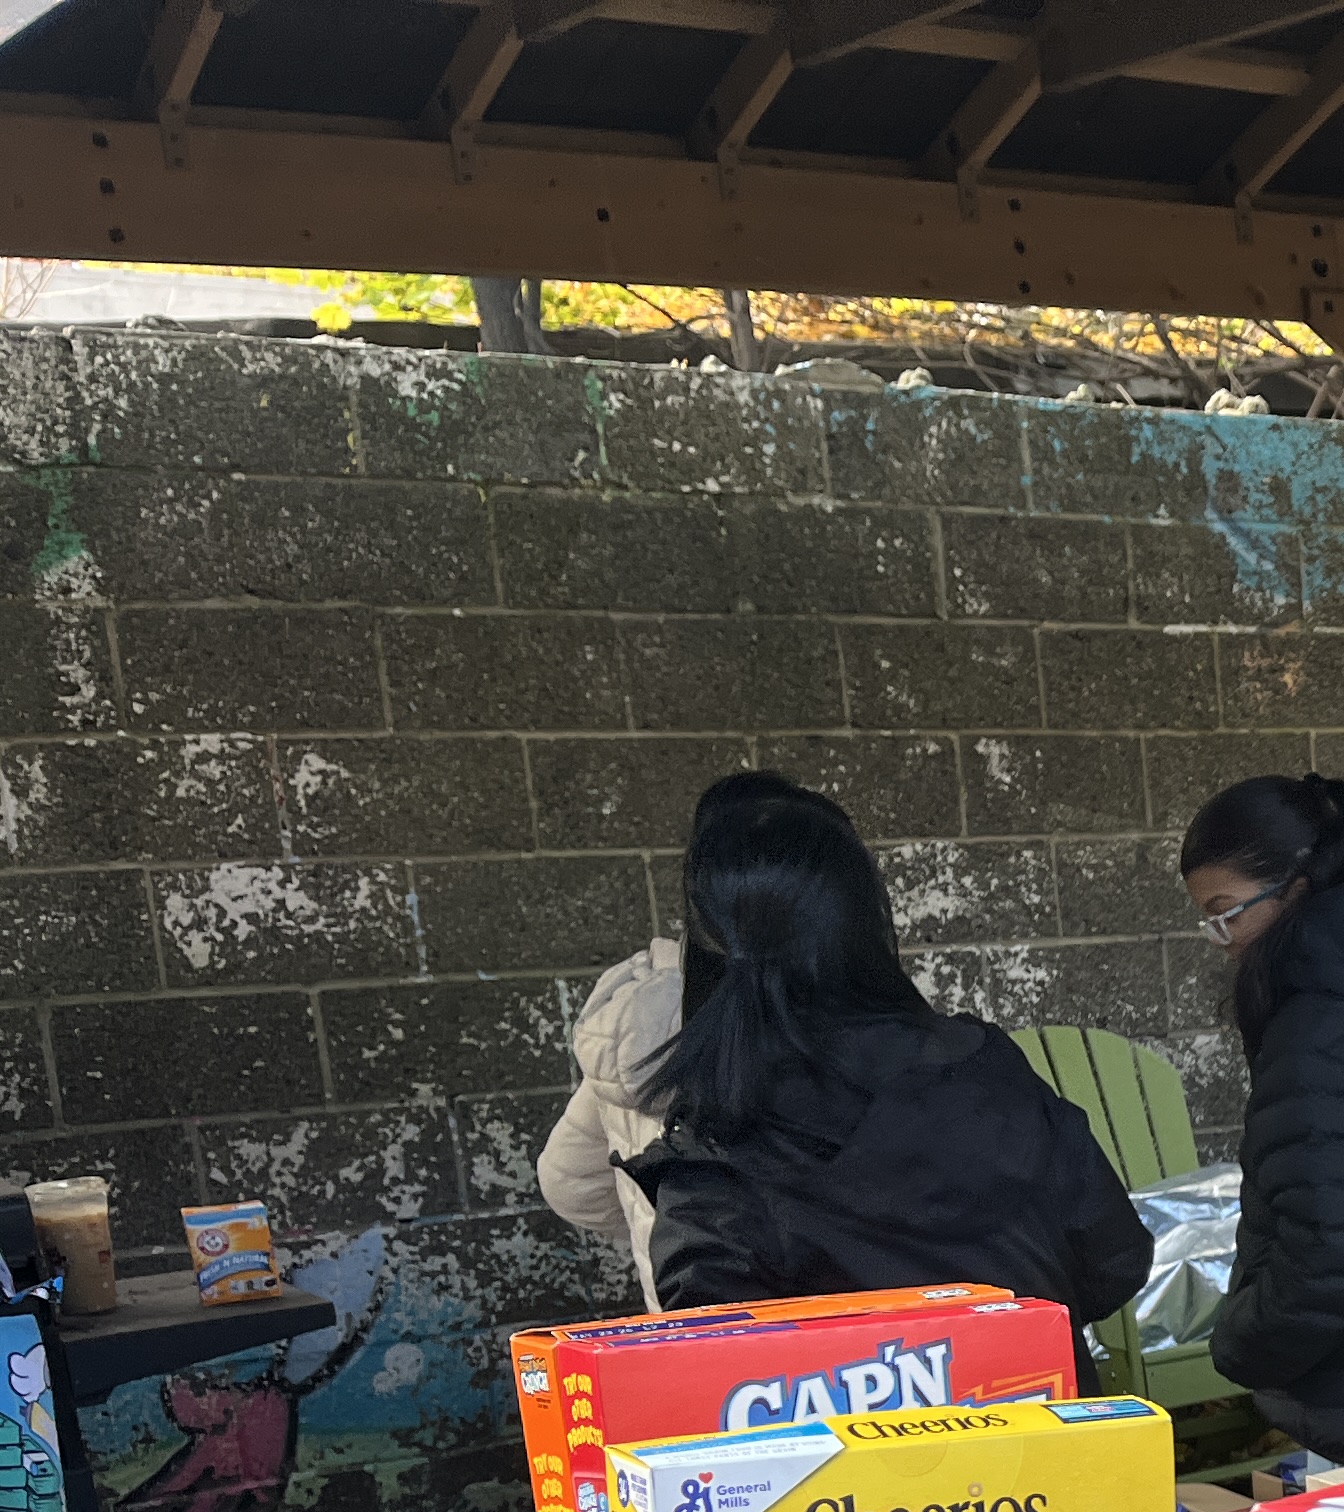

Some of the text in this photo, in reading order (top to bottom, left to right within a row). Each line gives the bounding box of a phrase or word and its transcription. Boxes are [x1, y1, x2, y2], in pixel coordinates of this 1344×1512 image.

[563, 1371, 593, 1396] TRY OUR
[571, 1398, 593, 1421] OTHER
[846, 1410, 1009, 1442] Cheerios
[716, 1480, 772, 1498] General
[718, 1494, 750, 1510] Mills
